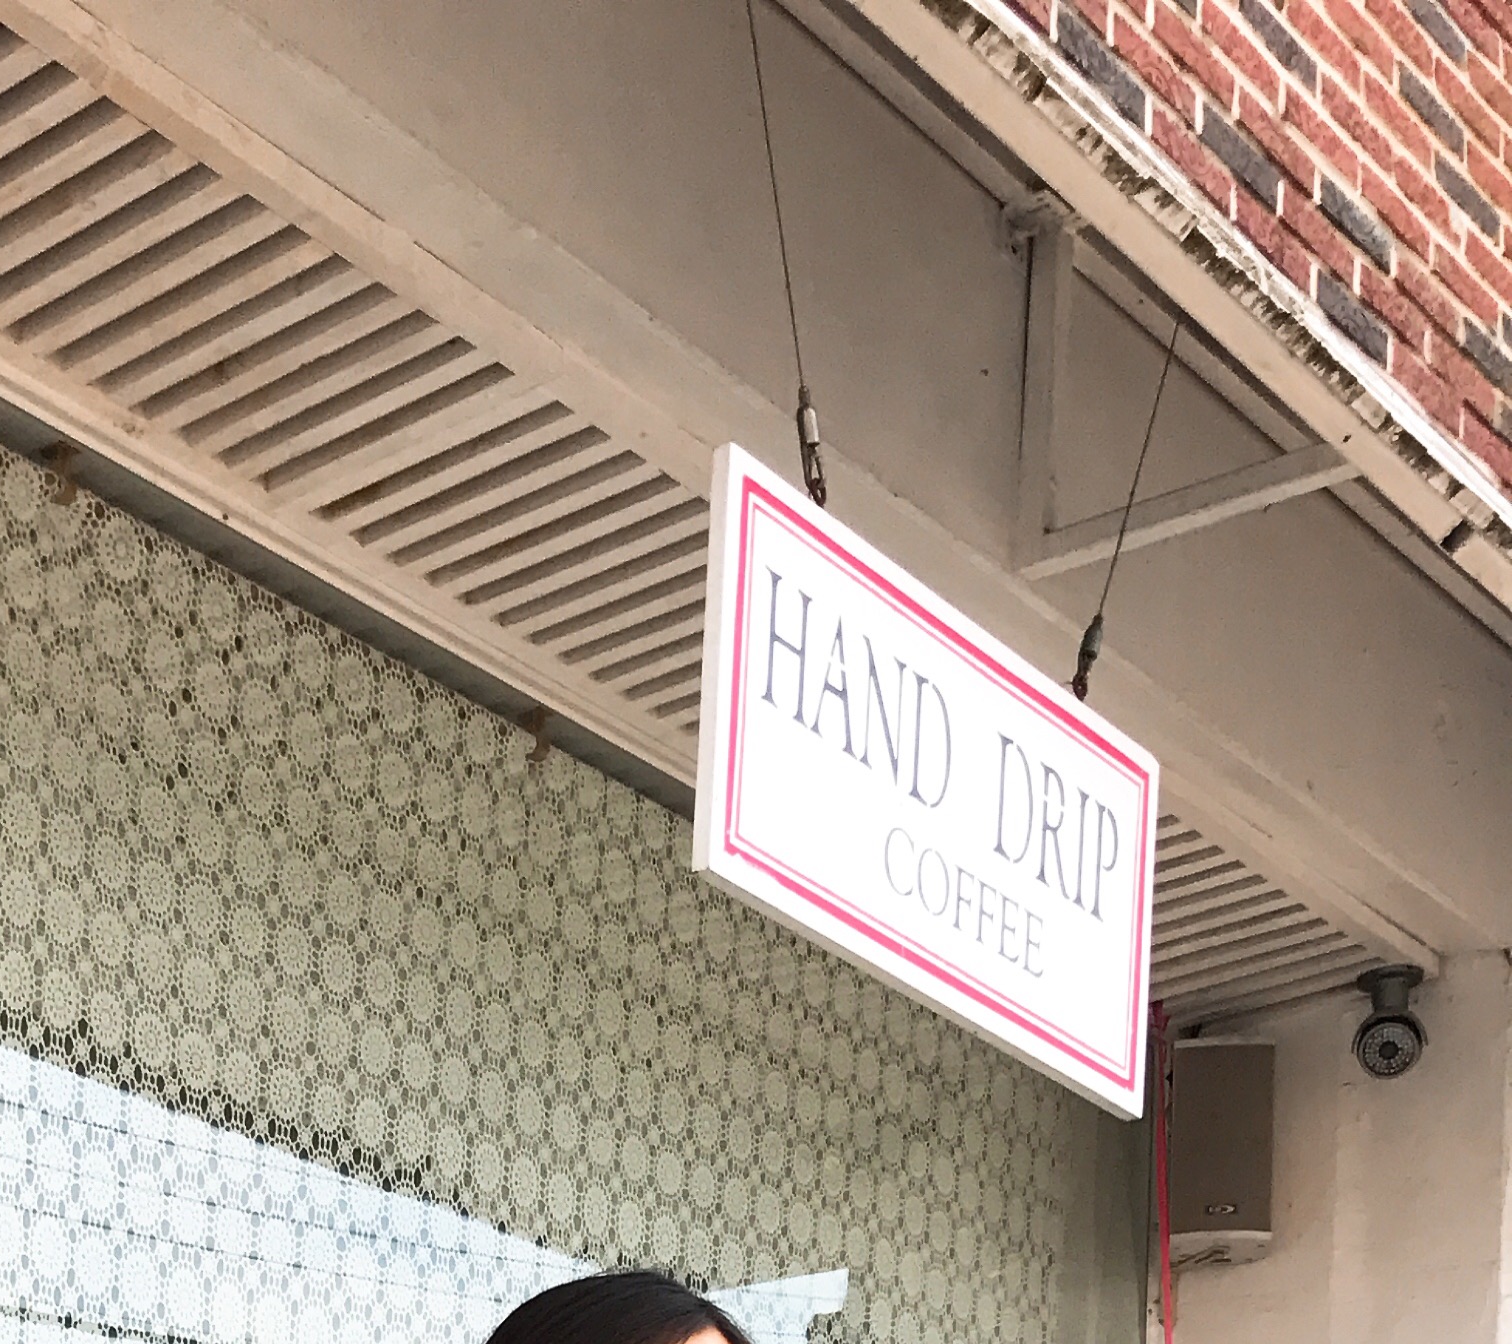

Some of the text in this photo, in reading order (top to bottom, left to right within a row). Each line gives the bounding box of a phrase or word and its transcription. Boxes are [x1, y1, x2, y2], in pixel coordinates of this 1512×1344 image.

[761, 565, 1119, 922] HAND DRIP
[884, 827, 1044, 978] COFFEE
